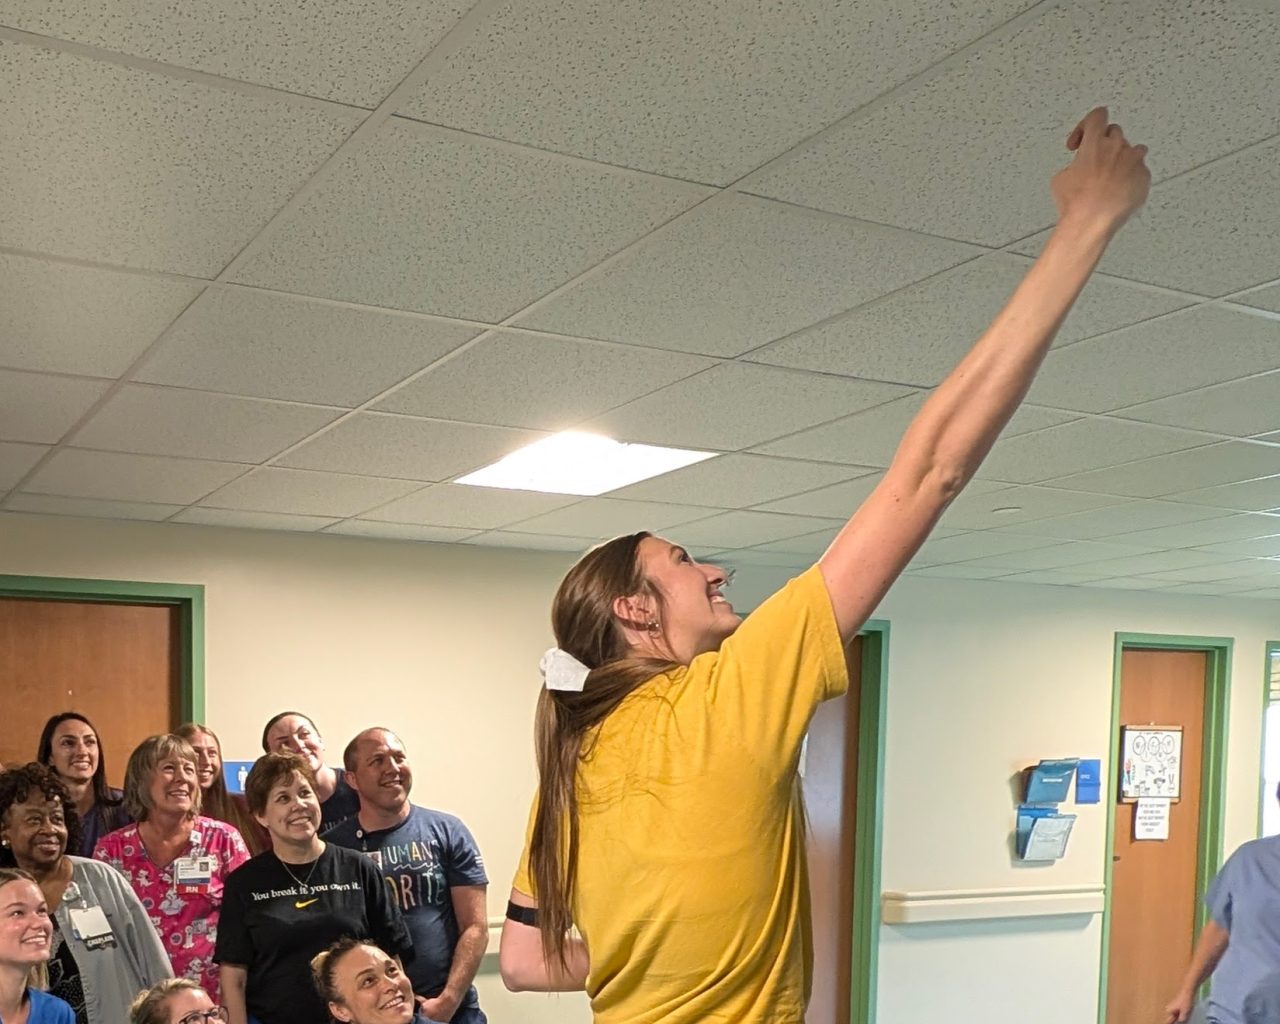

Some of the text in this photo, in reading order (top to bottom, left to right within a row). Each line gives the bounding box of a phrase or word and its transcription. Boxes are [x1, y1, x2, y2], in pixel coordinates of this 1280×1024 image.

[252, 892, 270, 901] You
[271, 887, 297, 898] break
[310, 884, 328, 895] you
[330, 882, 350, 891] own
[352, 881, 361, 890] it.
[384, 870, 446, 910] ORITE
